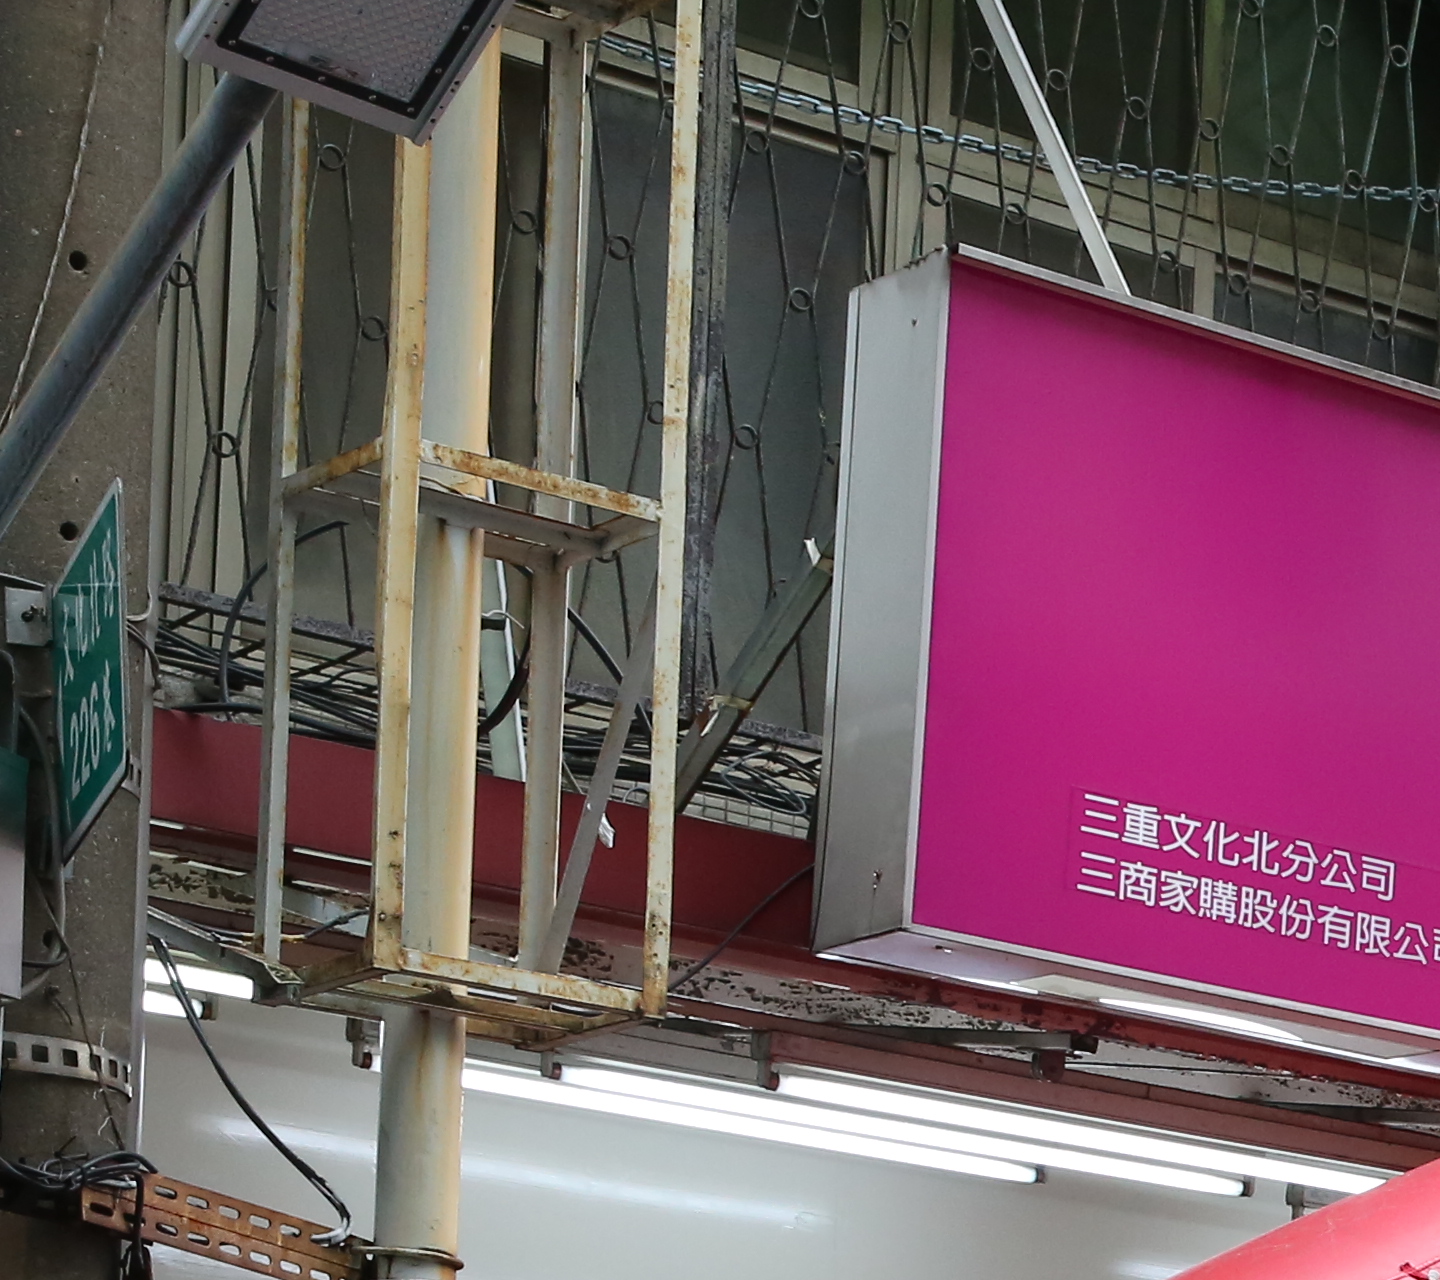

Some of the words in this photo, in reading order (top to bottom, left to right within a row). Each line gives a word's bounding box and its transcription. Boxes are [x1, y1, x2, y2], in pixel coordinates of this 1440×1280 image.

[1080, 792, 1396, 901] 三重文化北分公司
